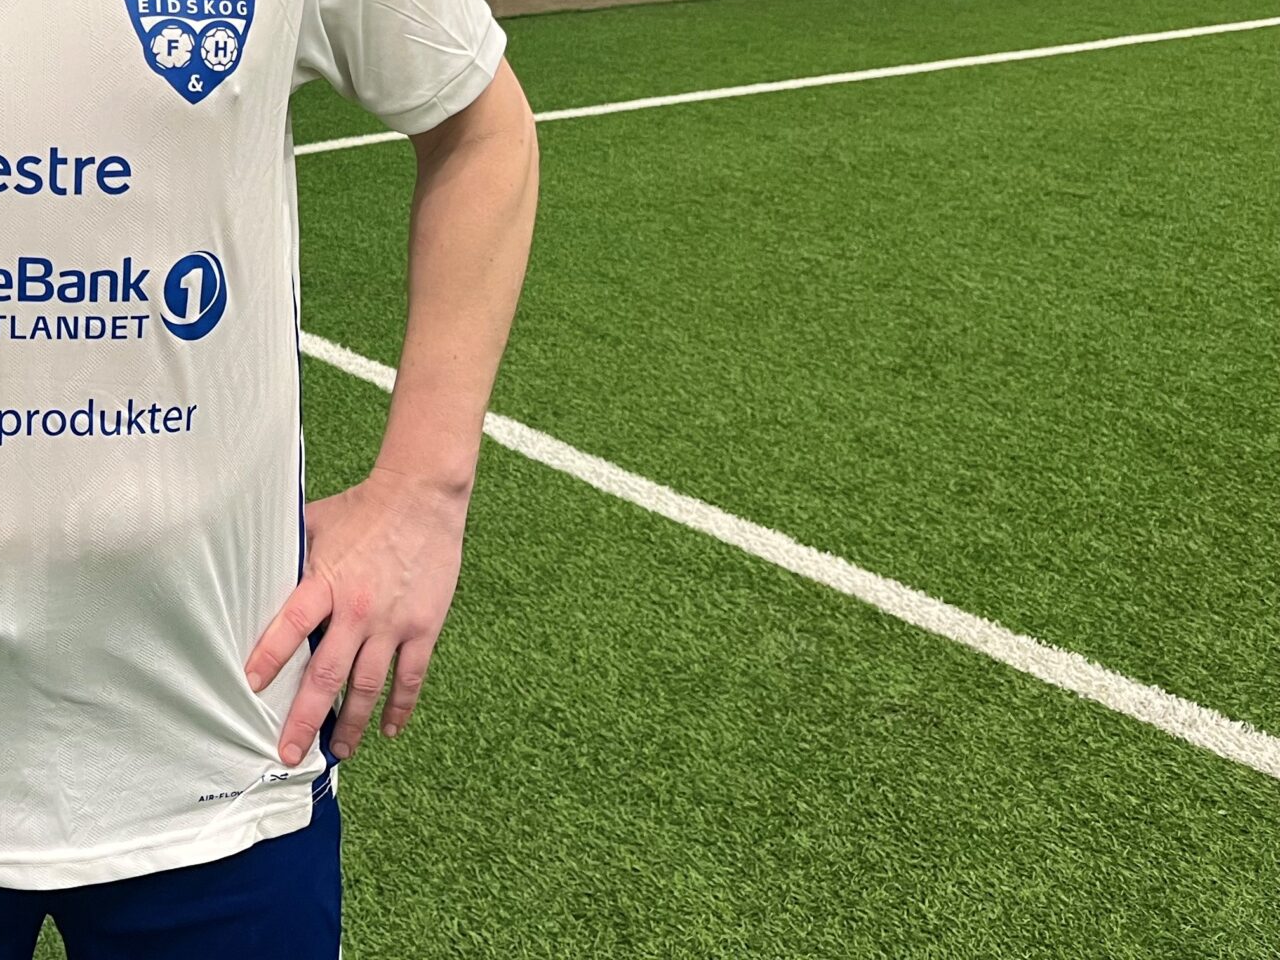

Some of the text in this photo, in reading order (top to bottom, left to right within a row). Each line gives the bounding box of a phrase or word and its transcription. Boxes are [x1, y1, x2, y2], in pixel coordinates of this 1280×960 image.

[167, 39, 179, 56] F
[214, 40, 228, 58] H
[187, 74, 203, 92] &
